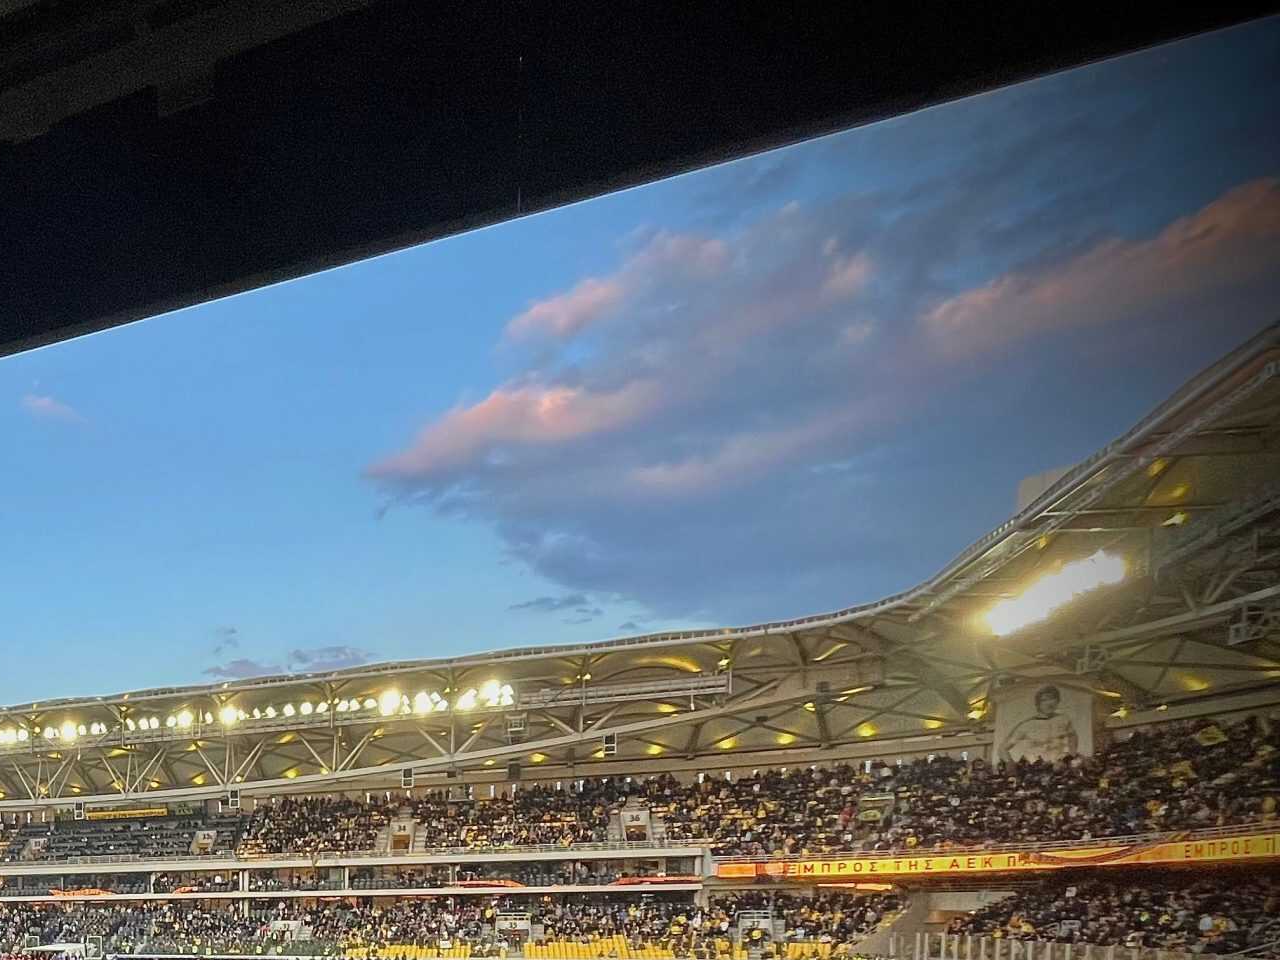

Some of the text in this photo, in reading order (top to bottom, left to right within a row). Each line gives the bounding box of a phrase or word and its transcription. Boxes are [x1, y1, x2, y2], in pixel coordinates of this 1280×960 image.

[787, 861, 877, 874] ΕΜΠΡΟΣ
[894, 860, 934, 871] ΤΗΣ
[949, 856, 993, 869] ΑΕΚ
